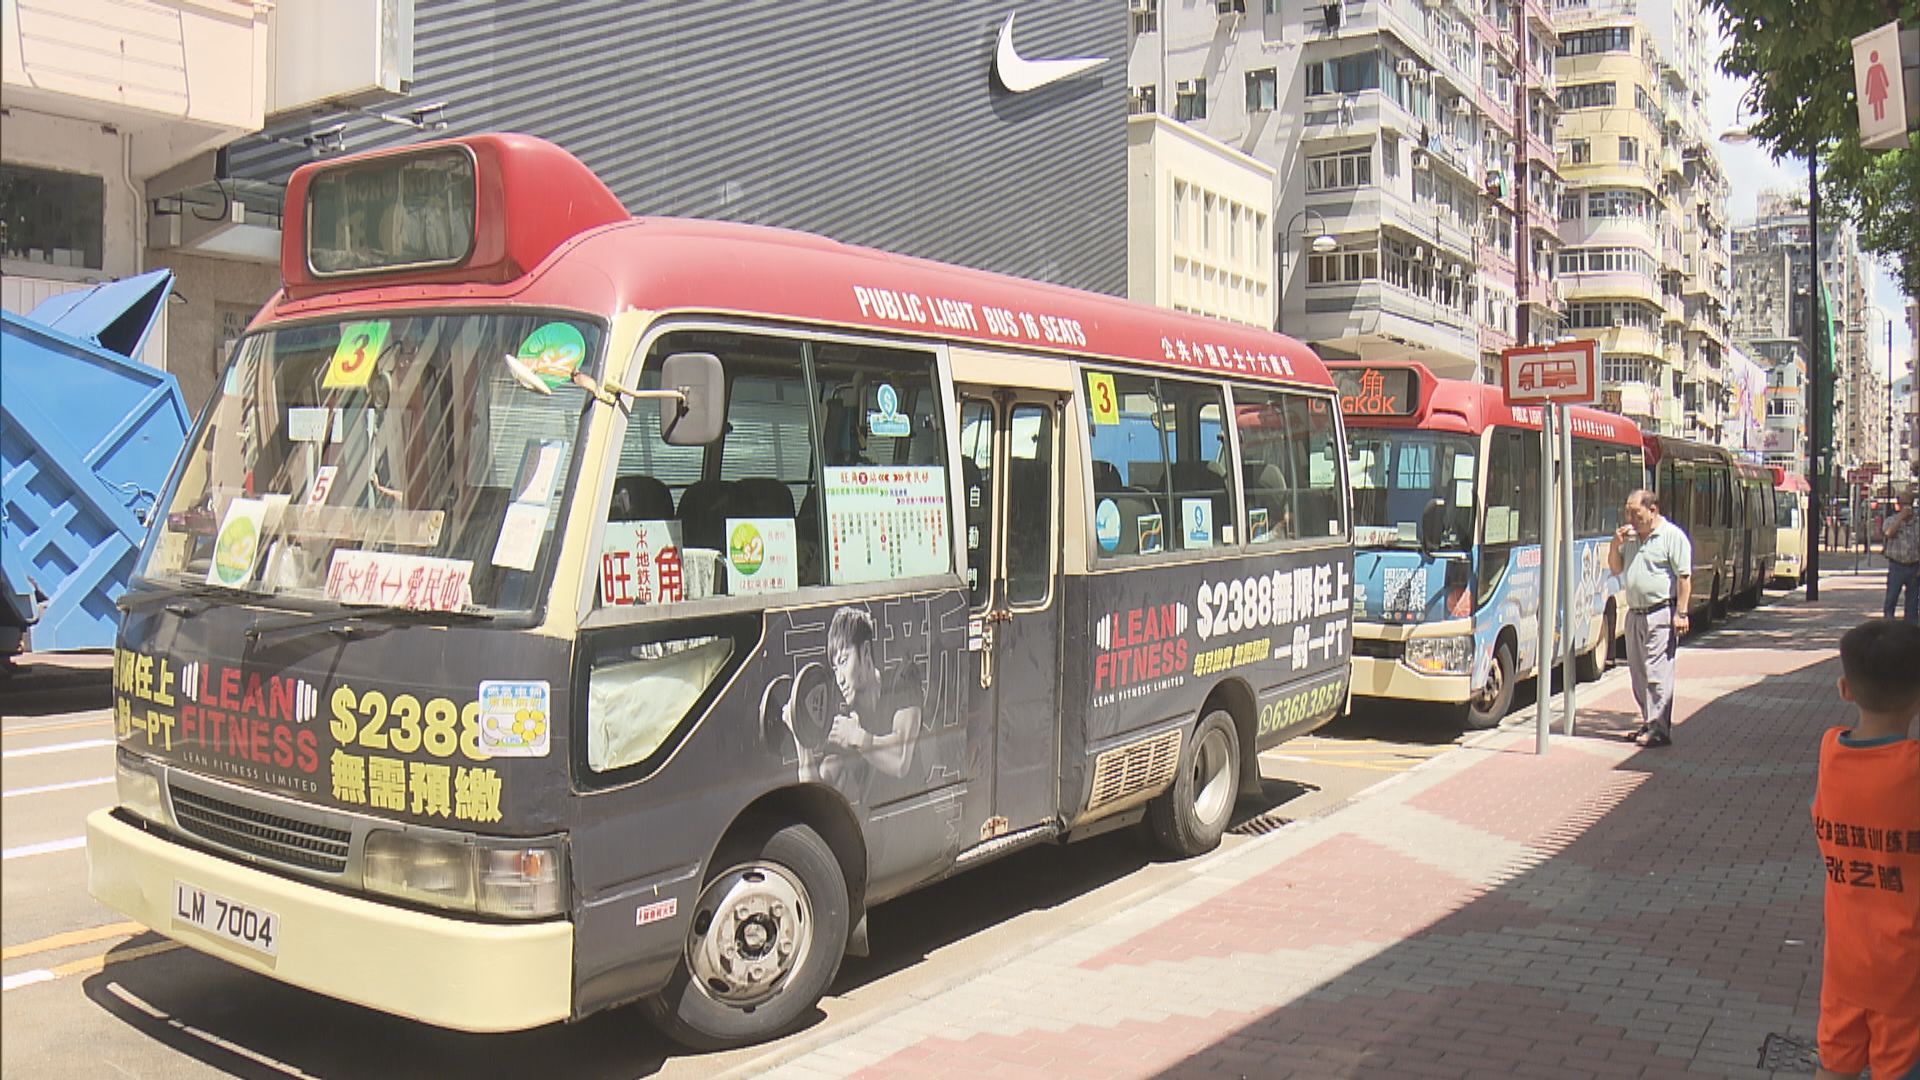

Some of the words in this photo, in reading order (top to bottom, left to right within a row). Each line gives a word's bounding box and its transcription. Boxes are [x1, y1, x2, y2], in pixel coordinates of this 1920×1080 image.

[853, 285, 927, 324] PUBLIC
[927, 296, 979, 332] LIGHT
[982, 305, 1019, 337] BUS
[1019, 311, 1040, 340] 16
[1039, 314, 1087, 347] SEATS
[342, 334, 371, 373] 3
[1161, 335, 1295, 376] 公共小型巴士十六座位
[1096, 381, 1112, 414] 3
[1359, 367, 1385, 398] 角
[312, 477, 329, 501] 5
[1111, 603, 1176, 649] LEAN
[1094, 638, 1188, 690] FITNESS
[199, 662, 295, 722] LEAN
[1093, 693, 1115, 708] LEAN
[1118, 683, 1151, 701] FITNESS
[1153, 675, 1184, 692] LIMITED
[181, 705, 319, 774] FITNESS
[329, 684, 493, 762] $2388
[183, 751, 208, 766] LEAN
[214, 758, 258, 780] FITNESS
[265, 771, 317, 793] LIMITED
[330, 748, 503, 824] 無需預繳
[177, 889, 205, 925] LM
[215, 900, 273, 948] 7004
